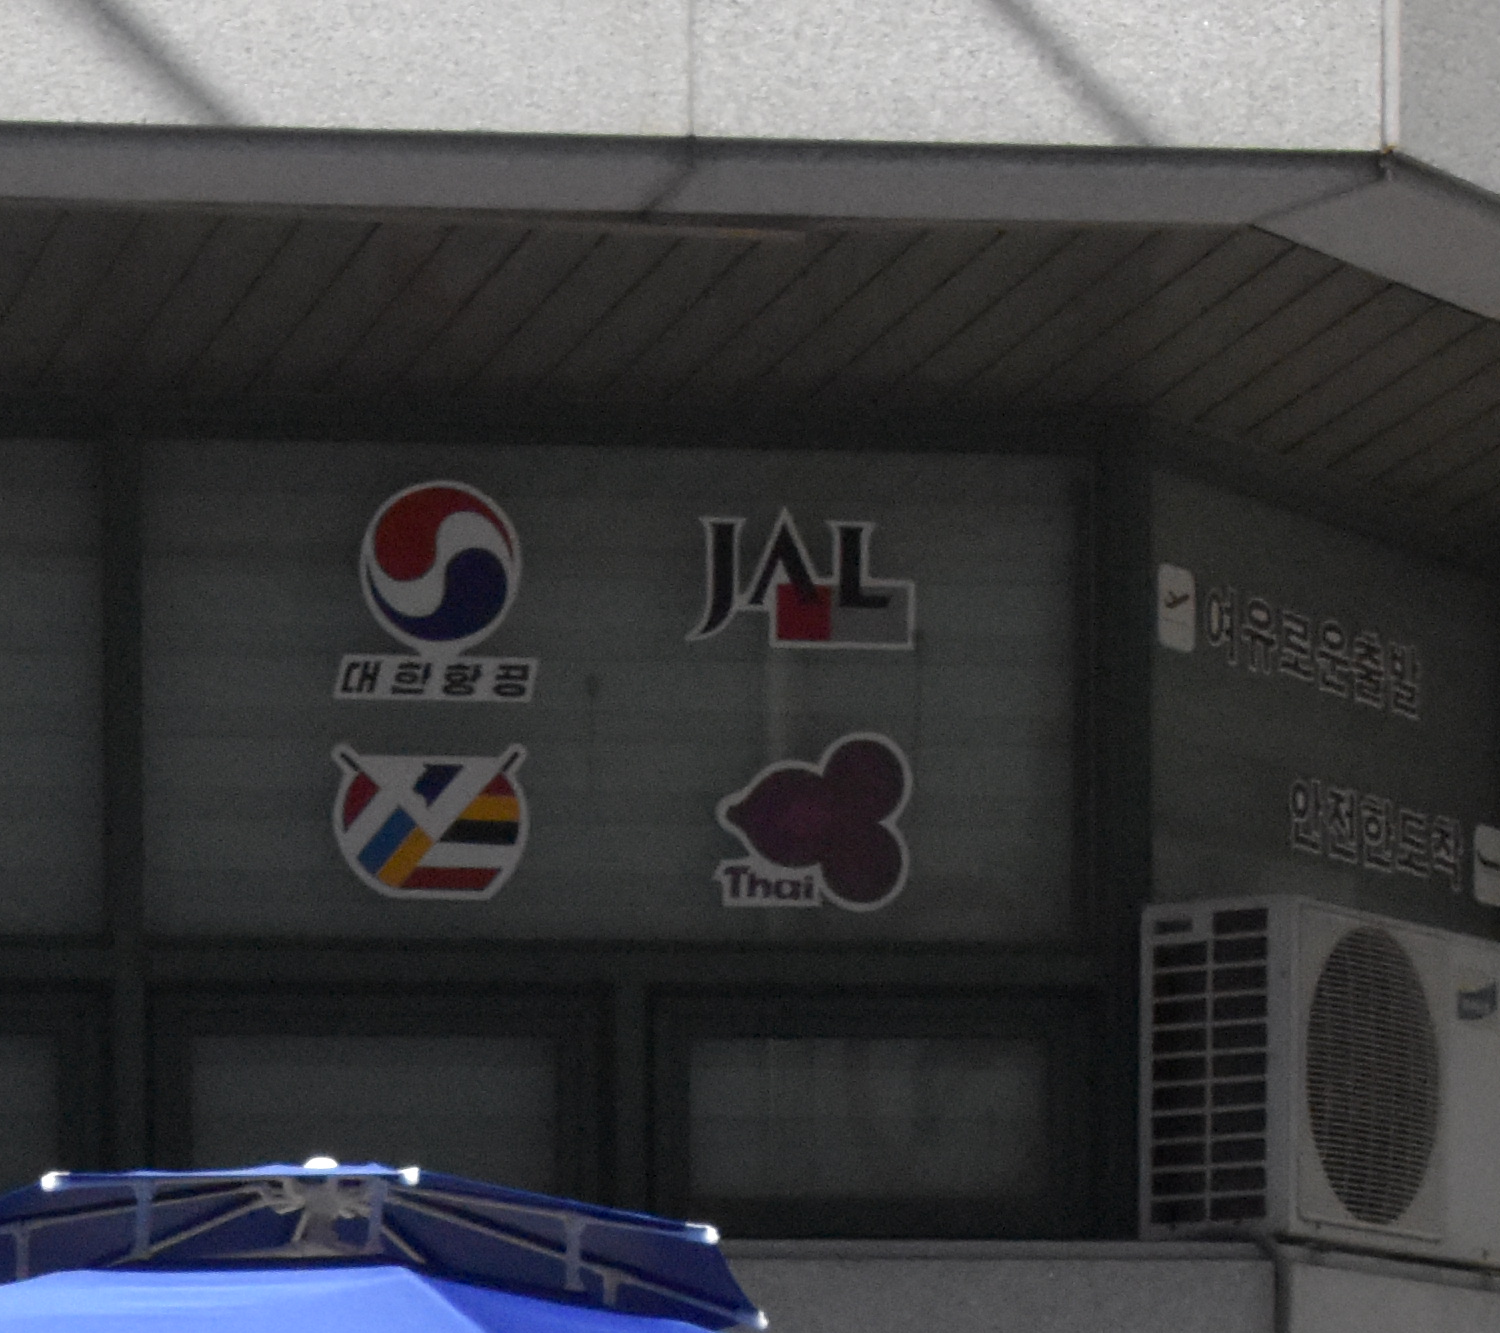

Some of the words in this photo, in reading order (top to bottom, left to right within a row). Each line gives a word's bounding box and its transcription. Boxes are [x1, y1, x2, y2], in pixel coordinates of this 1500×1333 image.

[688, 508, 894, 641] JAL
[340, 660, 532, 698] 대한항공
[723, 866, 815, 901] Thai
